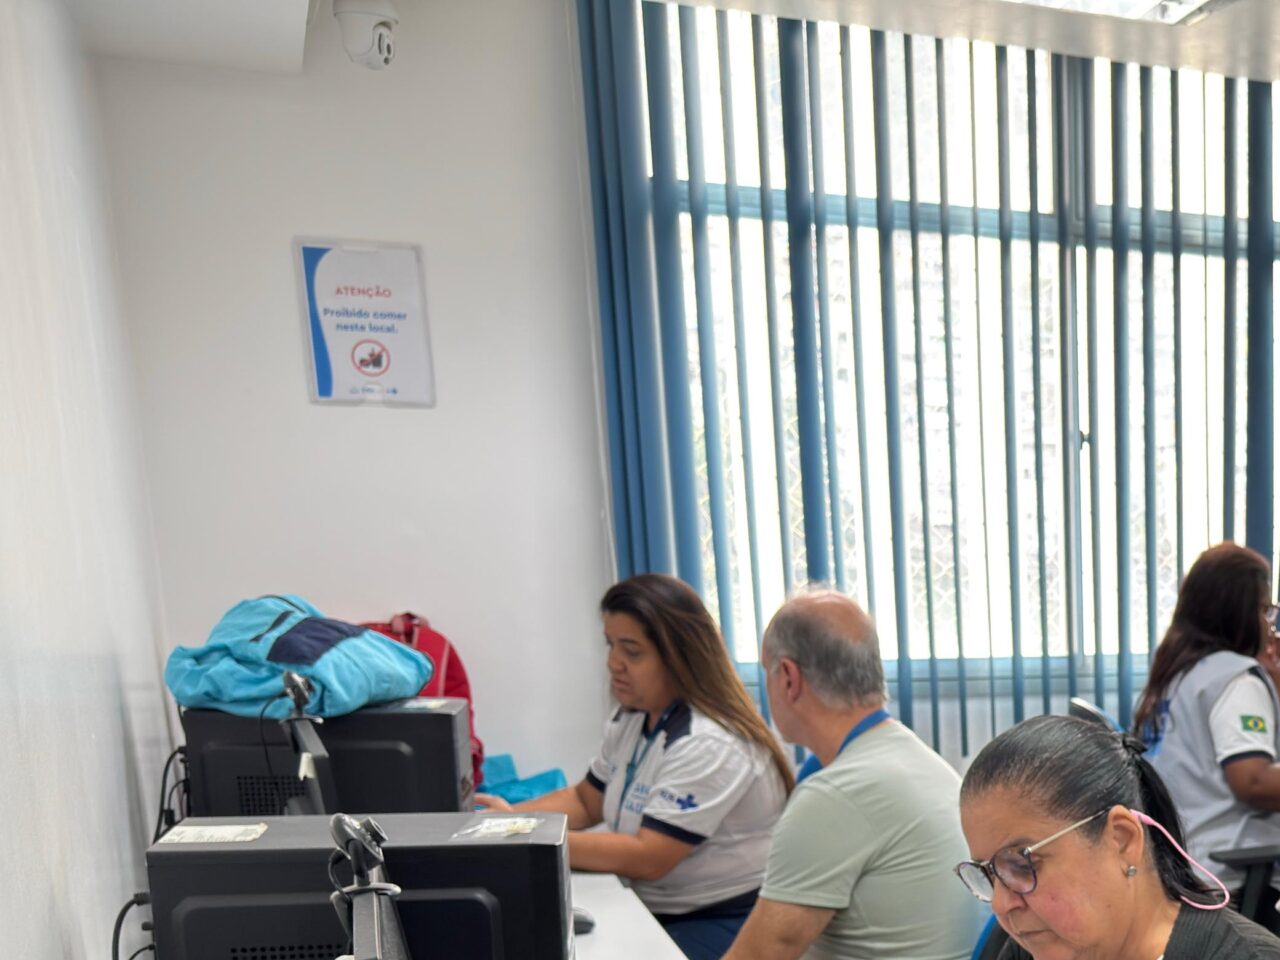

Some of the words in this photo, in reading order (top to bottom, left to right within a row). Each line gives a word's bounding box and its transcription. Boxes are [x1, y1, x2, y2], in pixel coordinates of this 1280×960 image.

[335, 285, 392, 298] ATENÇÃO
[323, 307, 370, 319] Proibido
[373, 312, 407, 321] comer
[336, 322, 366, 332] neste
[369, 323, 398, 333] local.
